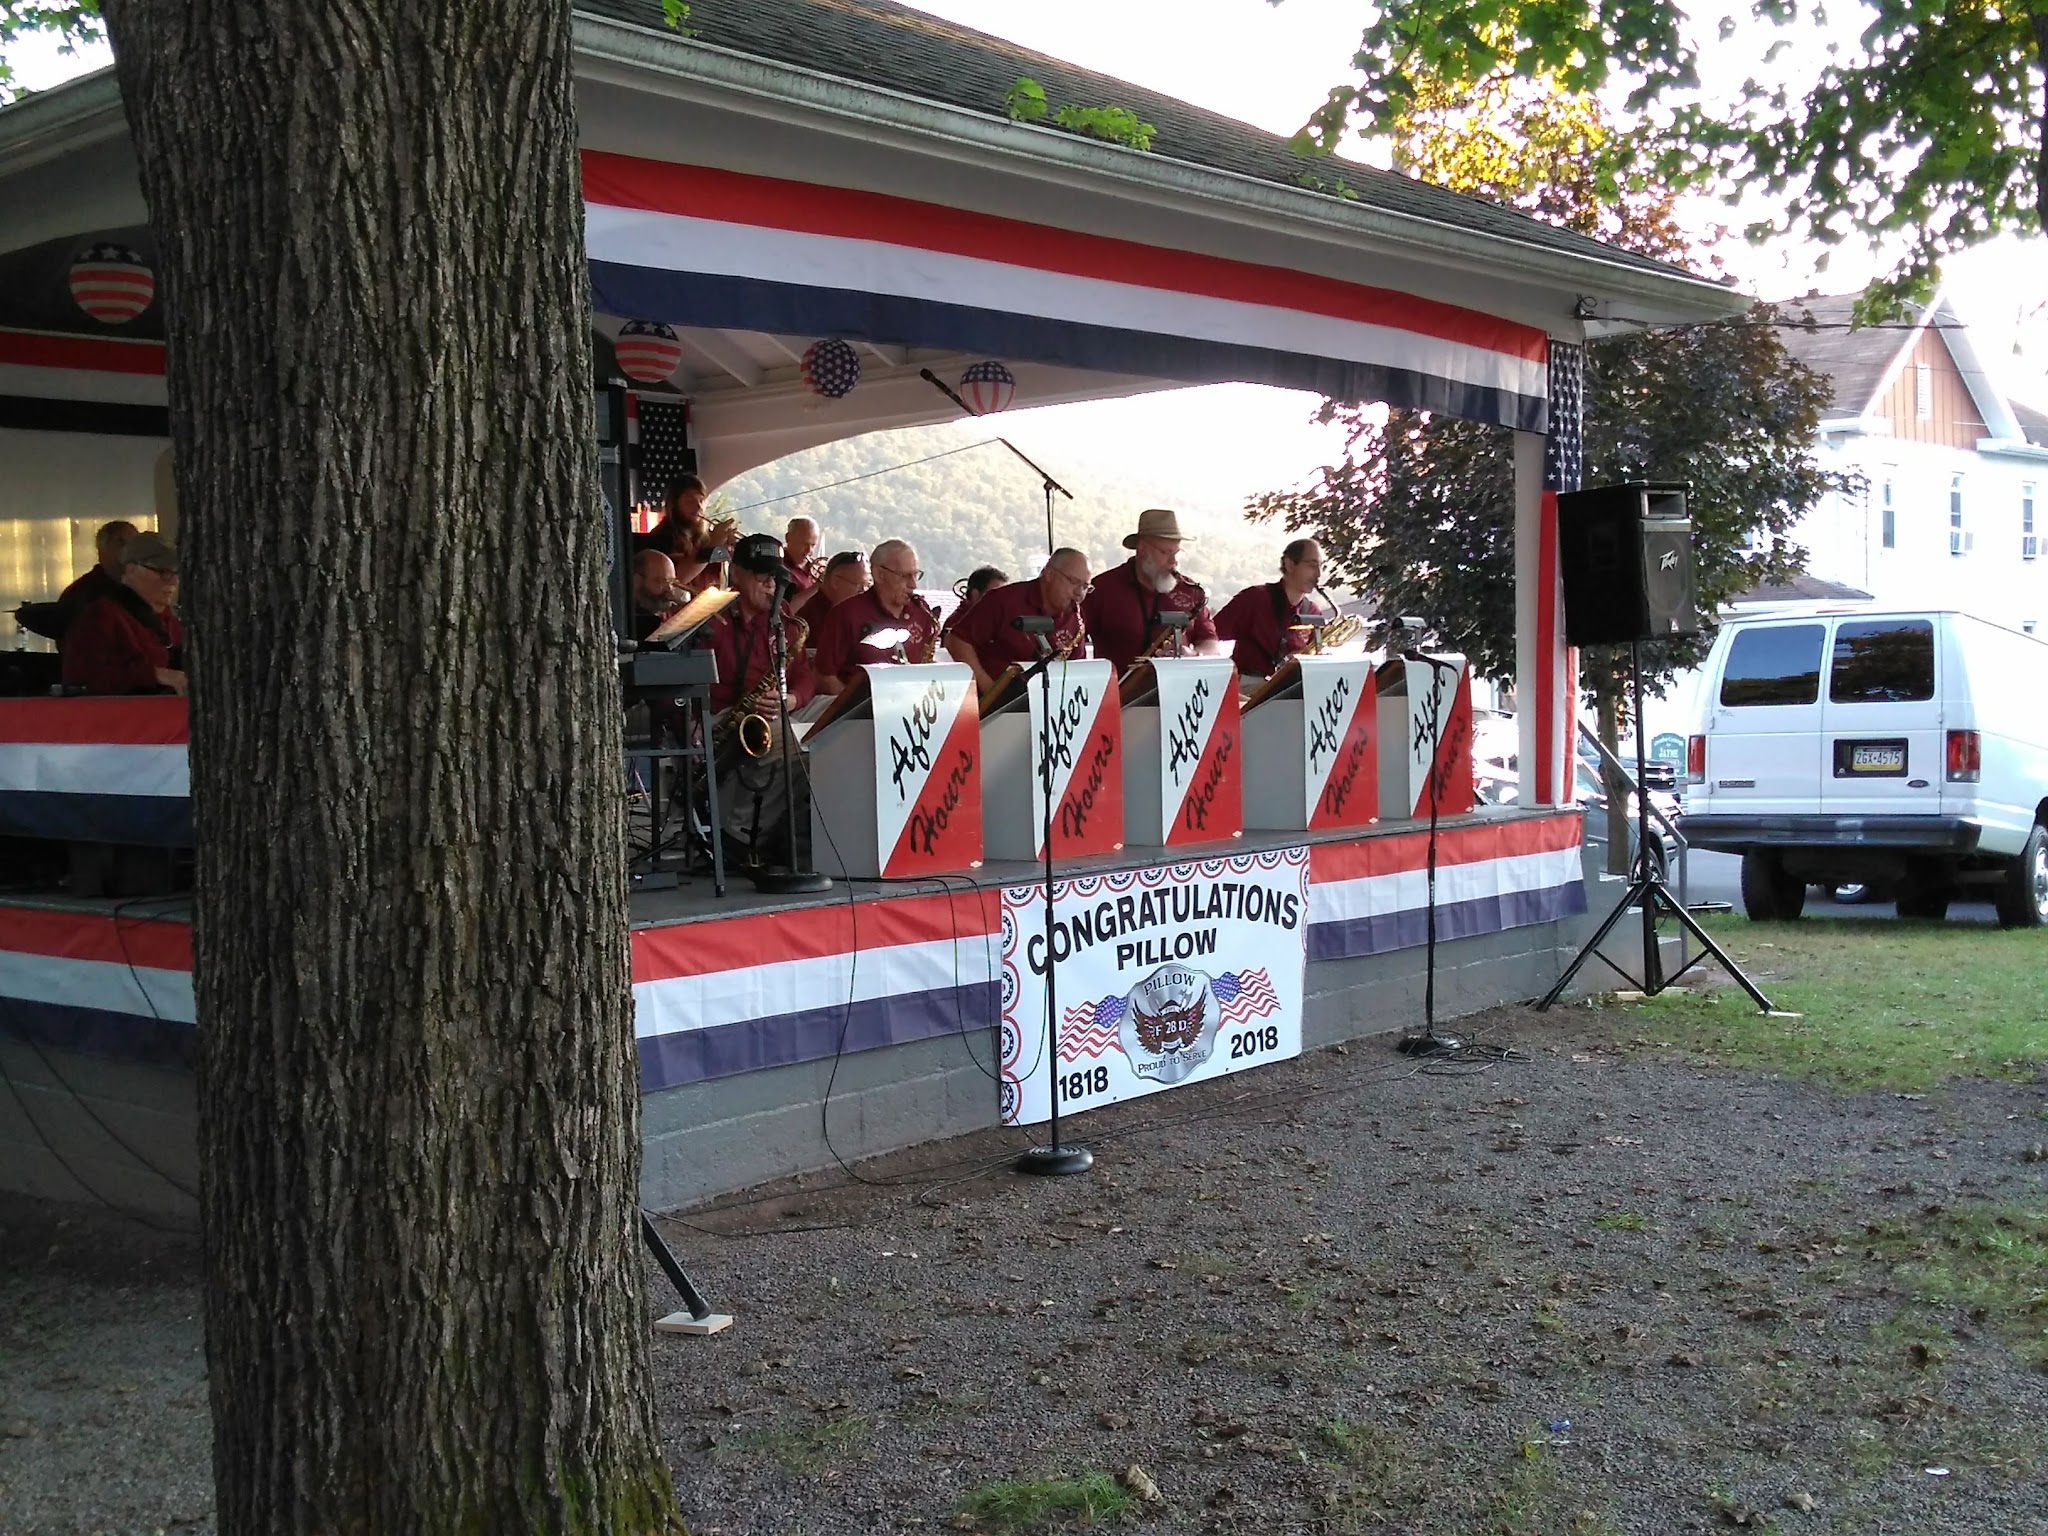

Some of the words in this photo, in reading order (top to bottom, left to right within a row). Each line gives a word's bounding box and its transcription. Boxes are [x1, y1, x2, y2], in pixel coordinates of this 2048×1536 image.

[890, 680, 946, 801] After
[1038, 685, 1090, 794] After
[1169, 679, 1210, 787] After
[1310, 676, 1350, 775] After
[1325, 727, 1369, 817] Hours
[910, 750, 973, 856] Hours
[1062, 734, 1115, 838] Hours
[1186, 730, 1233, 831] Hours
[1027, 883, 1299, 976] CONGRATULATIONS
[1117, 928, 1217, 971] PILLOW
[1143, 973, 1196, 996] PILLOW
[1165, 1020, 1177, 1034] 28
[1058, 1065, 1109, 1102] 1818
[1230, 1026, 1279, 1059] 2018
